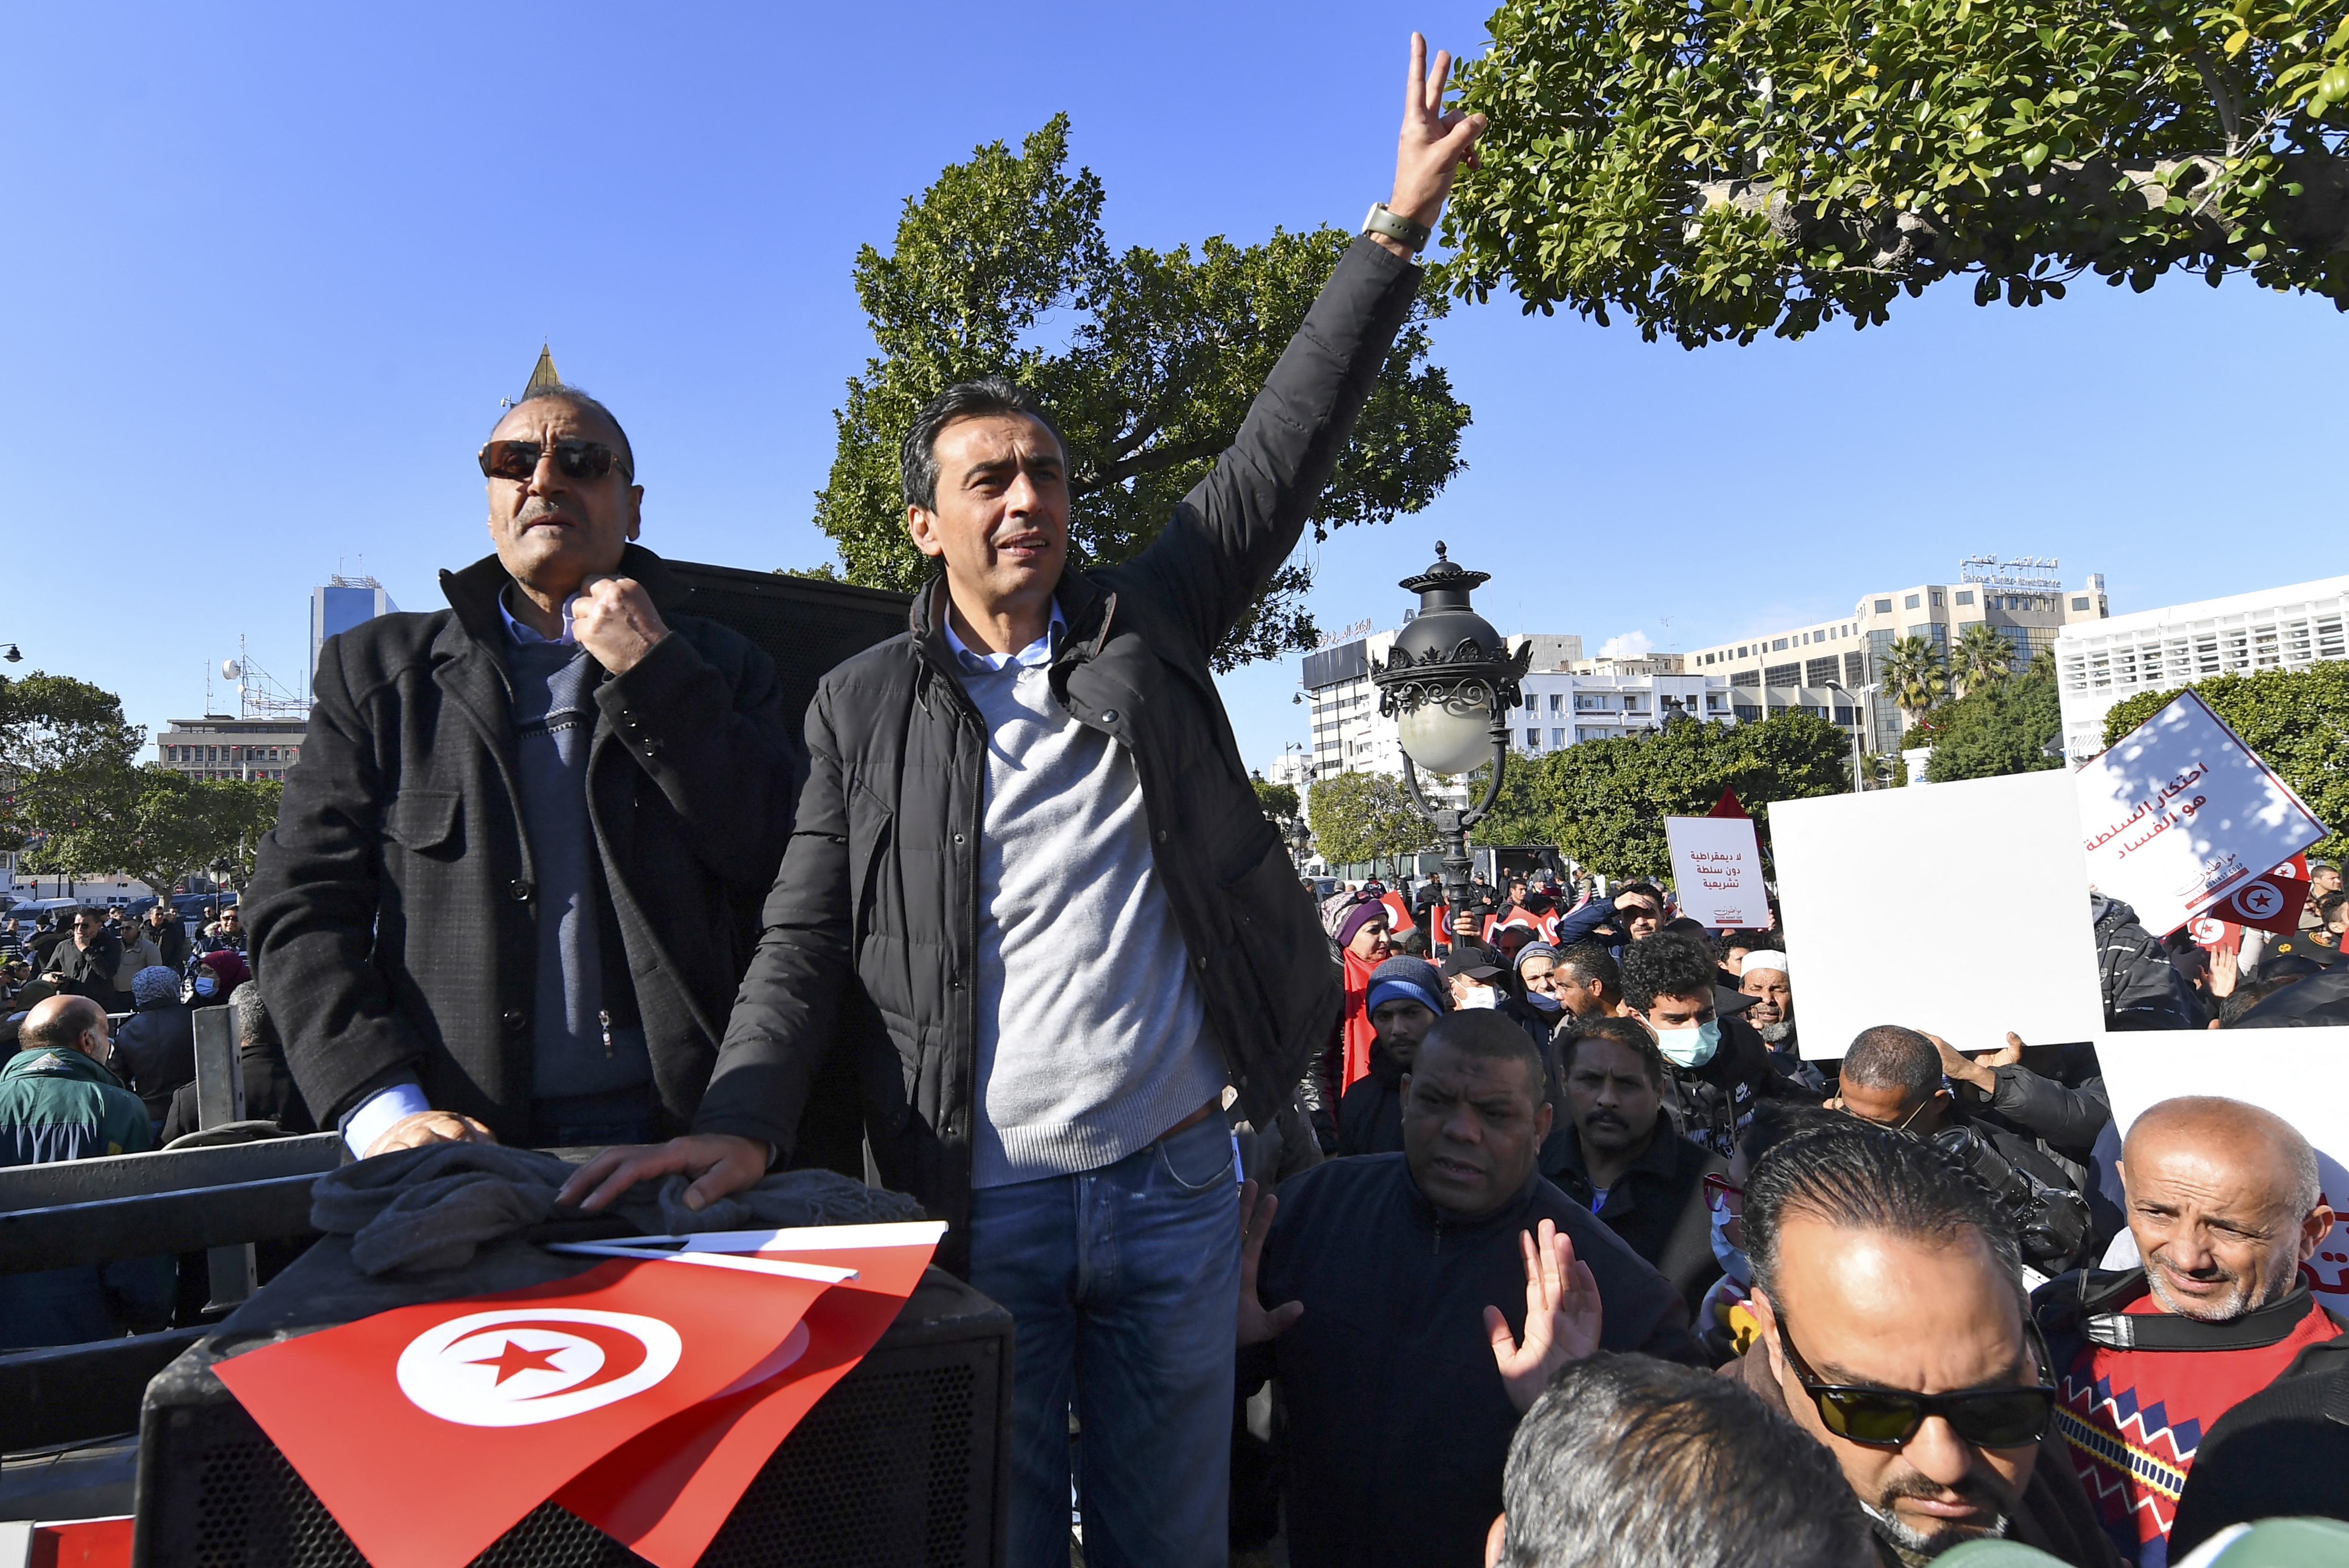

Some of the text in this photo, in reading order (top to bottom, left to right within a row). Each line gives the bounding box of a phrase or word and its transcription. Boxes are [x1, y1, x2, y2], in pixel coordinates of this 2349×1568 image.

[2083, 762, 2209, 851] احتكار السلطة
[2118, 795, 2206, 859] هو الفساد
[1691, 851, 1733, 863] ديمقراطية
[1697, 865, 1740, 876] دون سلطة
[2205, 872, 2228, 889] AGAINST
[2228, 863, 2243, 874] COUP
[1703, 877, 1739, 890] تشريعية
